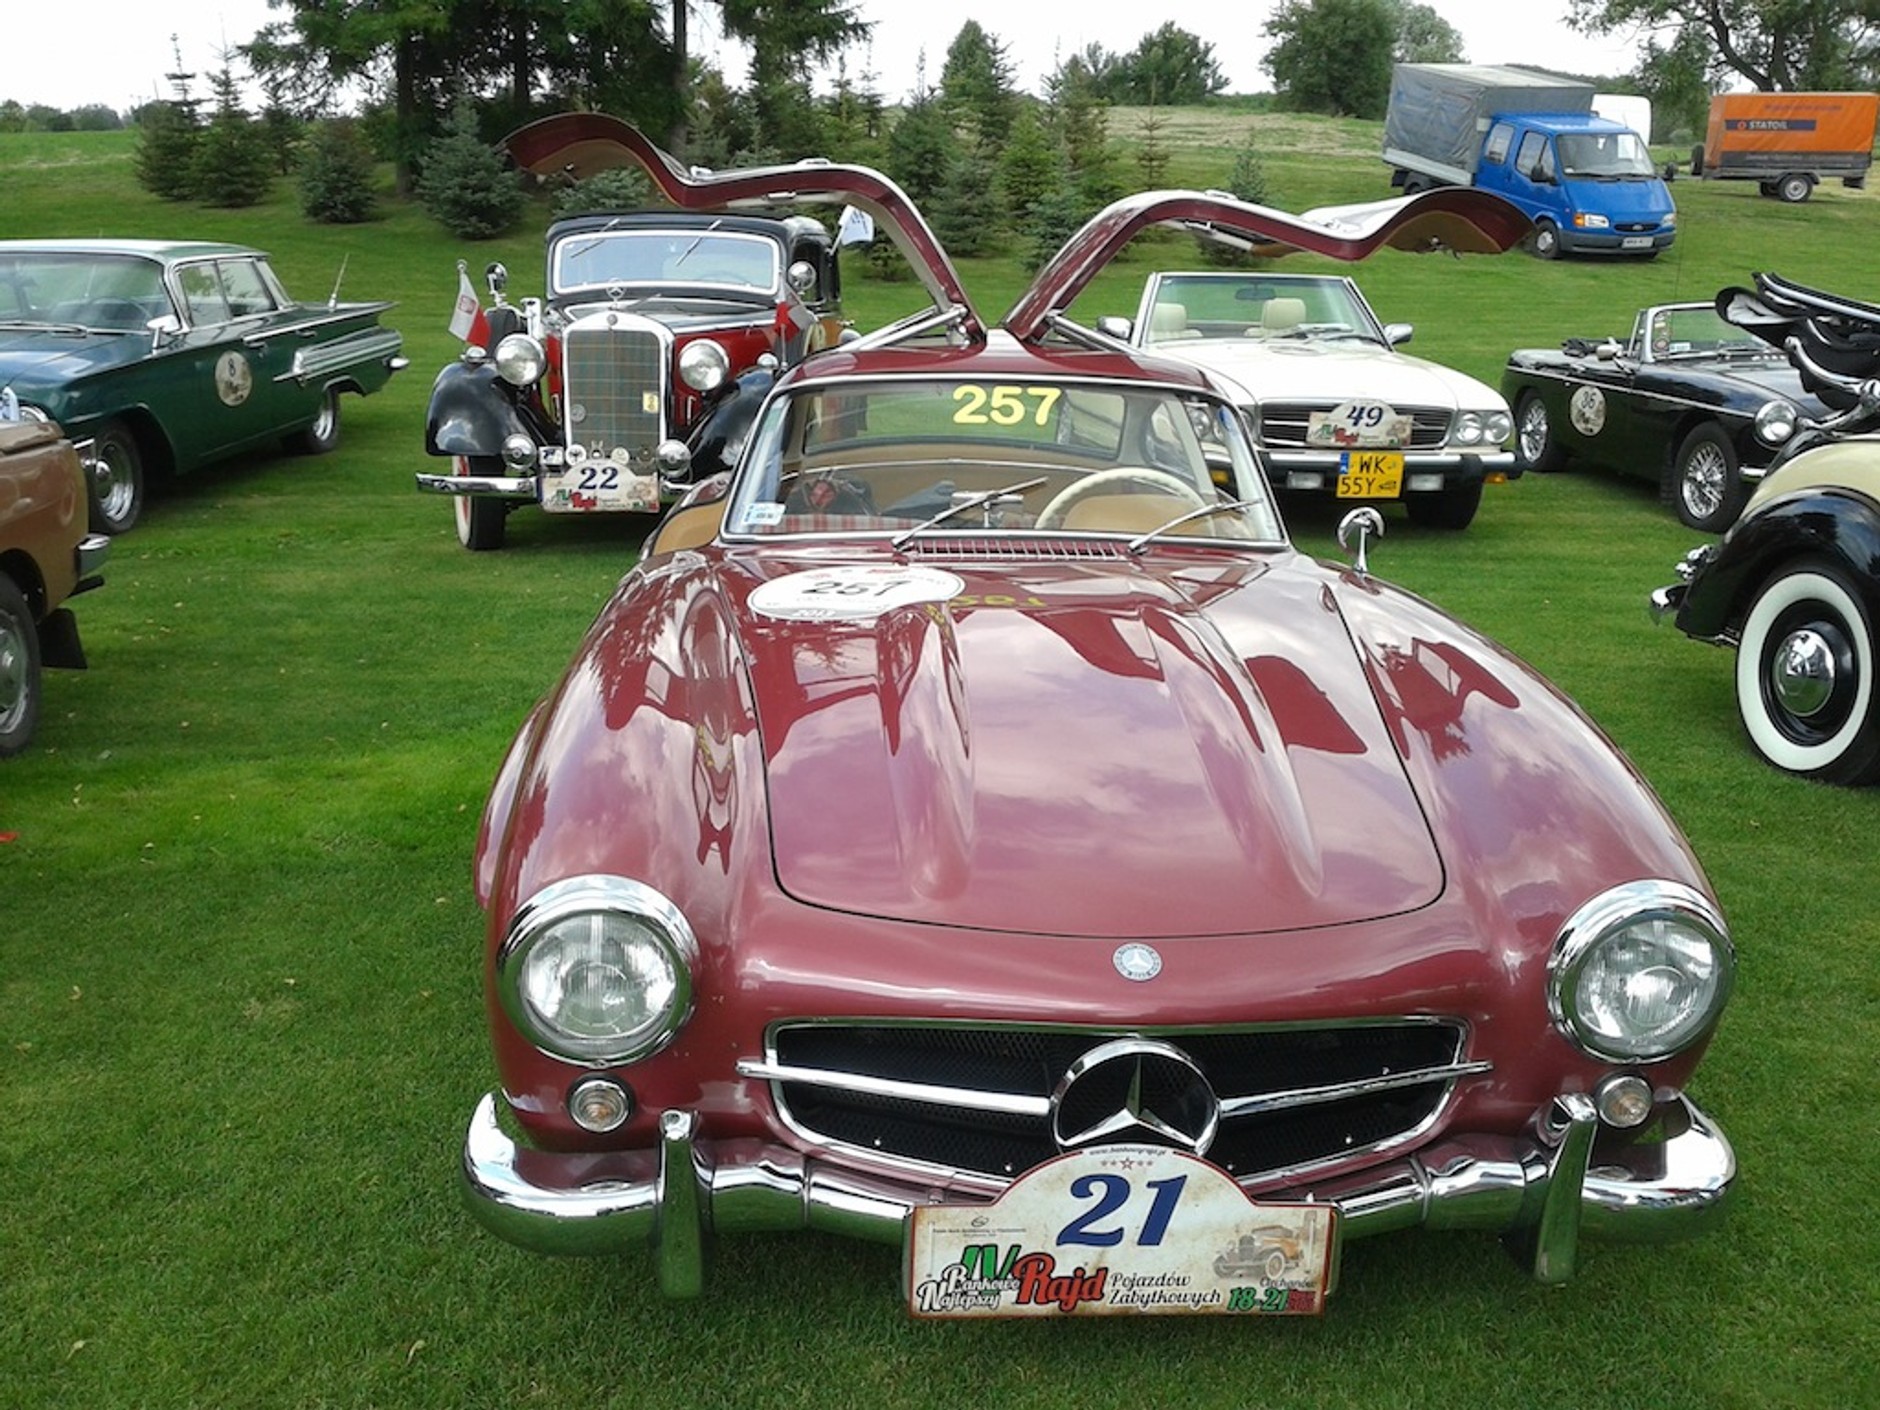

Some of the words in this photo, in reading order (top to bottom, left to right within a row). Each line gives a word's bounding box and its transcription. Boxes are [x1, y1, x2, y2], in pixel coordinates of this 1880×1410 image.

[1750, 120, 1788, 130] STATOIL
[952, 384, 1062, 427] 257
[1346, 406, 1383, 427] 49
[1359, 455, 1386, 475] WK
[578, 466, 618, 489] 22
[1340, 476, 1376, 495] 55Y
[802, 580, 911, 597] 257
[1056, 1172, 1189, 1247] 21
[960, 1244, 1022, 1281] IV
[1012, 1252, 1109, 1312] Rajd
[1109, 1271, 1191, 1291] Pojazdów
[917, 1280, 1002, 1311] Najlepszy
[1108, 1289, 1221, 1310] Zabytkowych
[1226, 1287, 1290, 1311] 18-21
